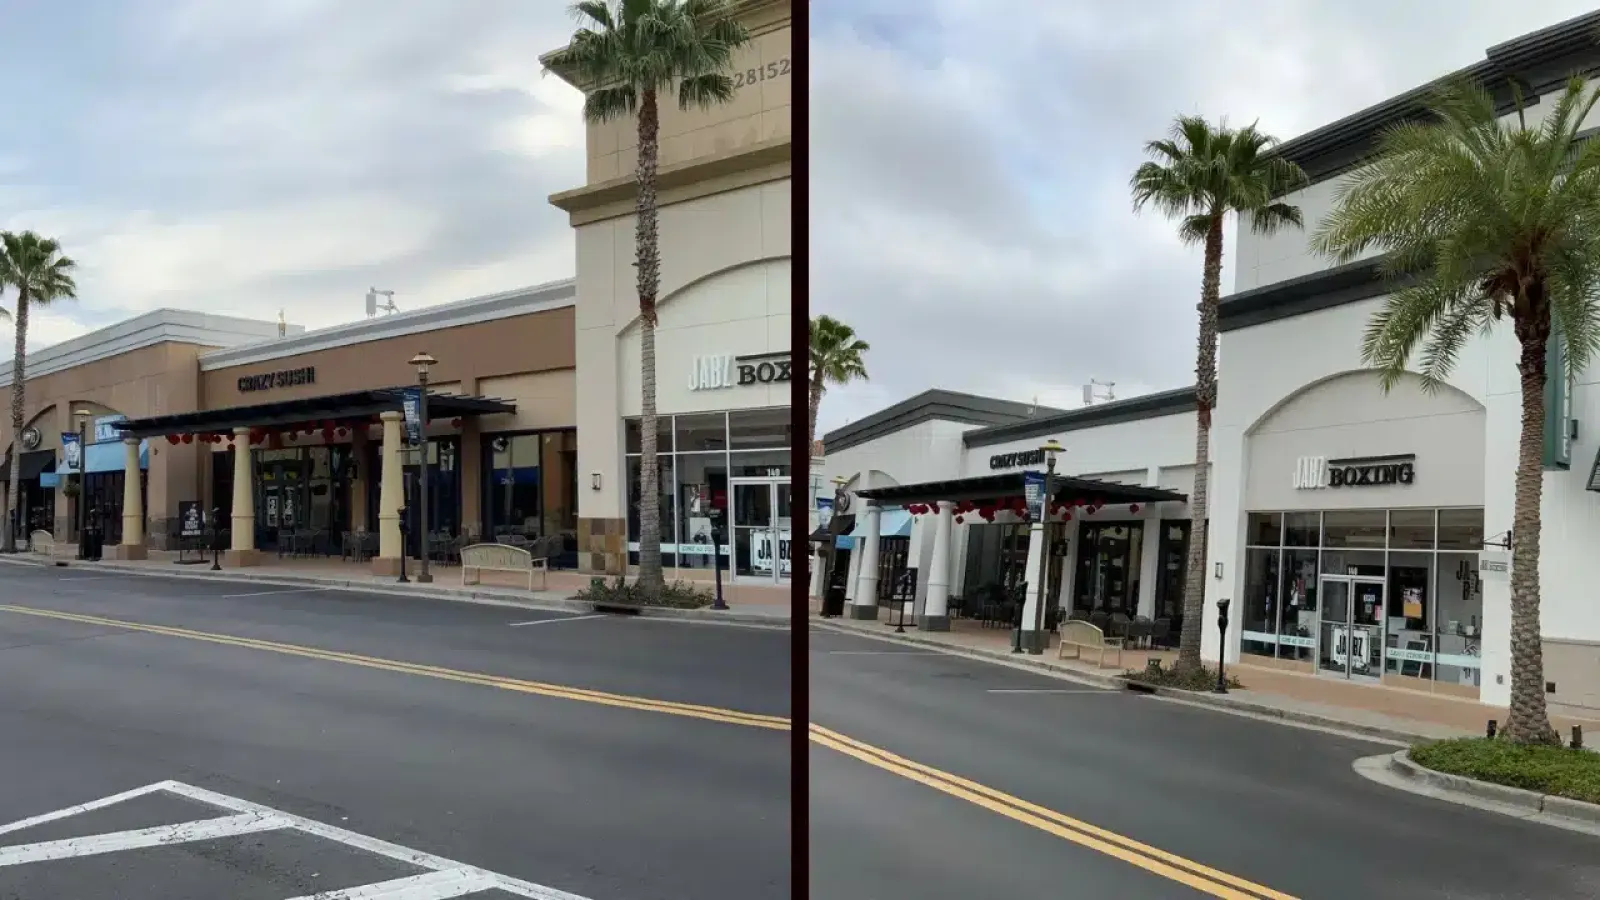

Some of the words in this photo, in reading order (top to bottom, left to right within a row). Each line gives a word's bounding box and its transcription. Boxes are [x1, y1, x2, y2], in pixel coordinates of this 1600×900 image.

[734, 58, 791, 90] 28152
[237, 372, 276, 391] CRAZY
[277, 366, 315, 387] SUSHI
[688, 354, 733, 391] JABZ
[736, 360, 791, 386] BOX
[990, 453, 1016, 469] CRAZY
[1016, 450, 1045, 466] SUSHI
[1293, 456, 1326, 489] JABZ
[1328, 463, 1415, 486] BOXING
